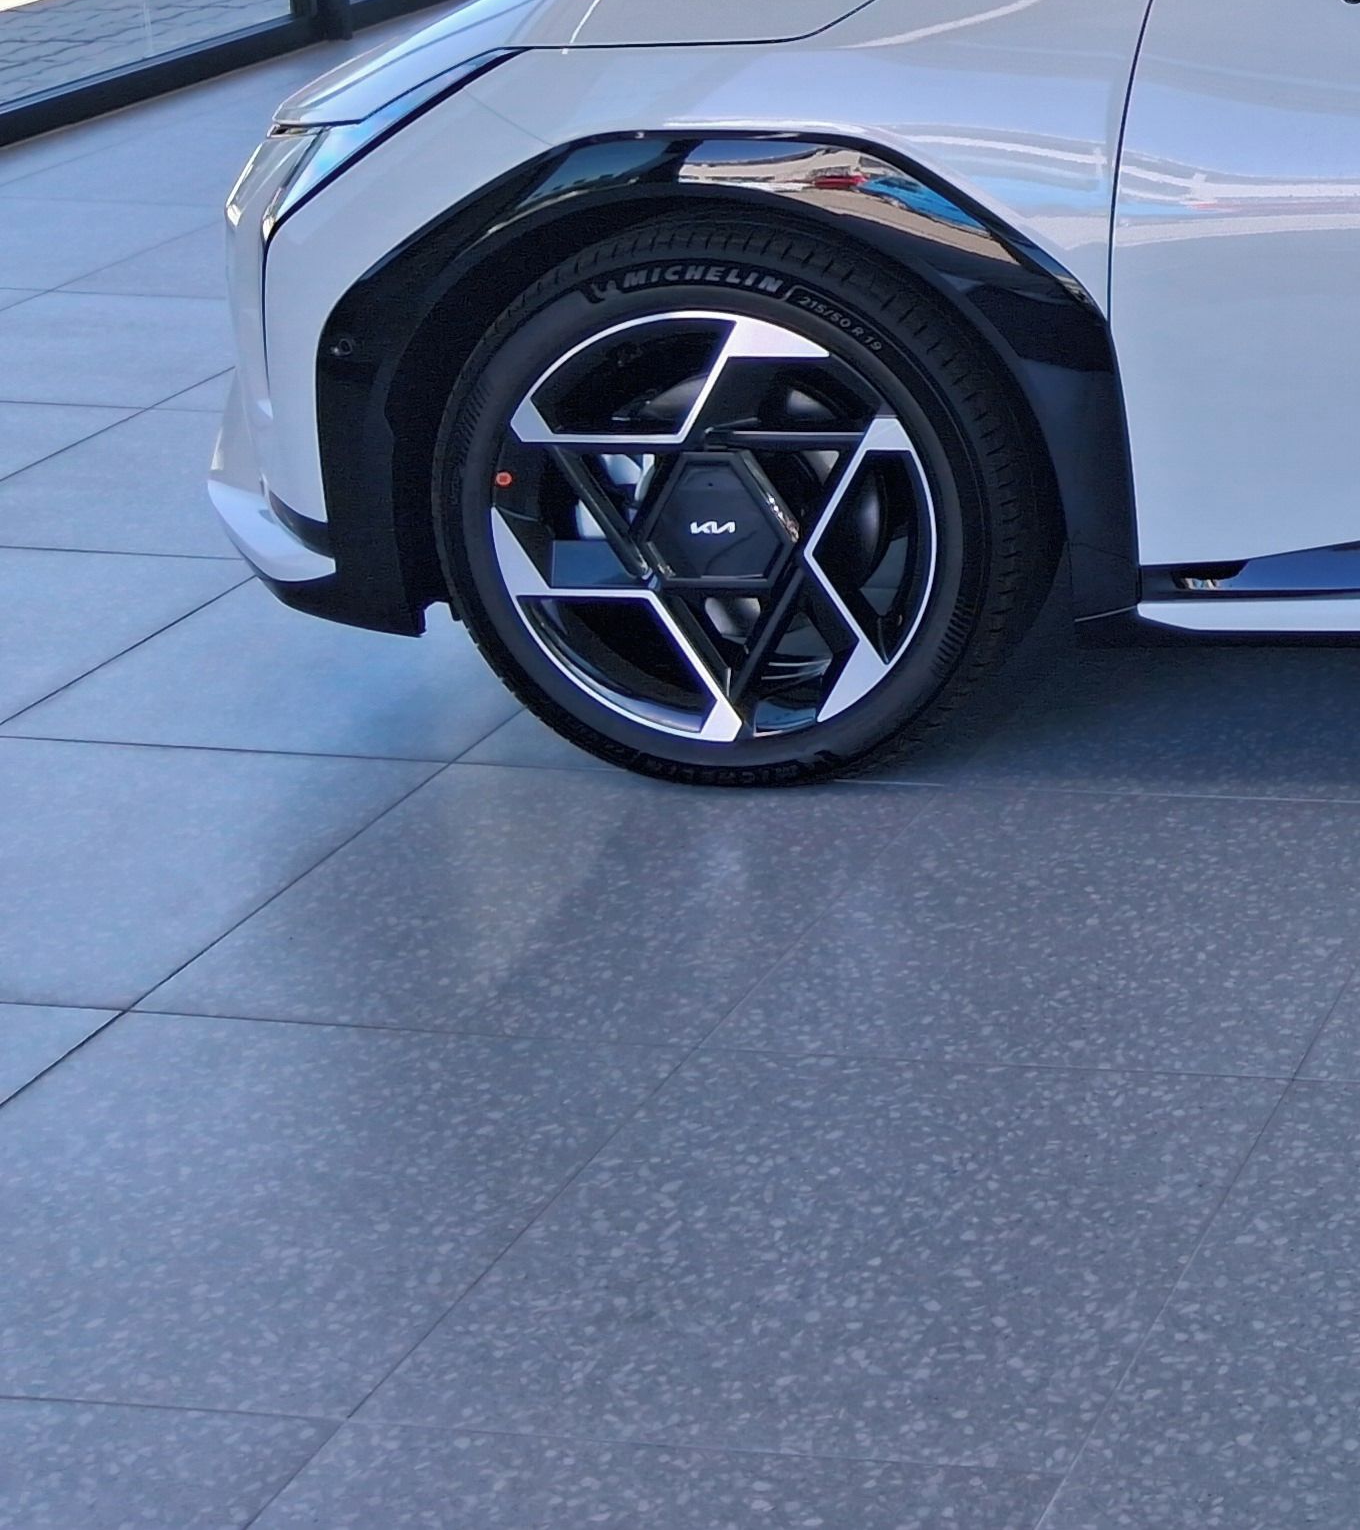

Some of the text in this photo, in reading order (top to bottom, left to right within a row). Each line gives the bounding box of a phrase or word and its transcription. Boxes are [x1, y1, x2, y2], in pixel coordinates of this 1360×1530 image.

[623, 265, 883, 351] MICHELIN 215/50 R 19
[690, 521, 736, 535] KIA
